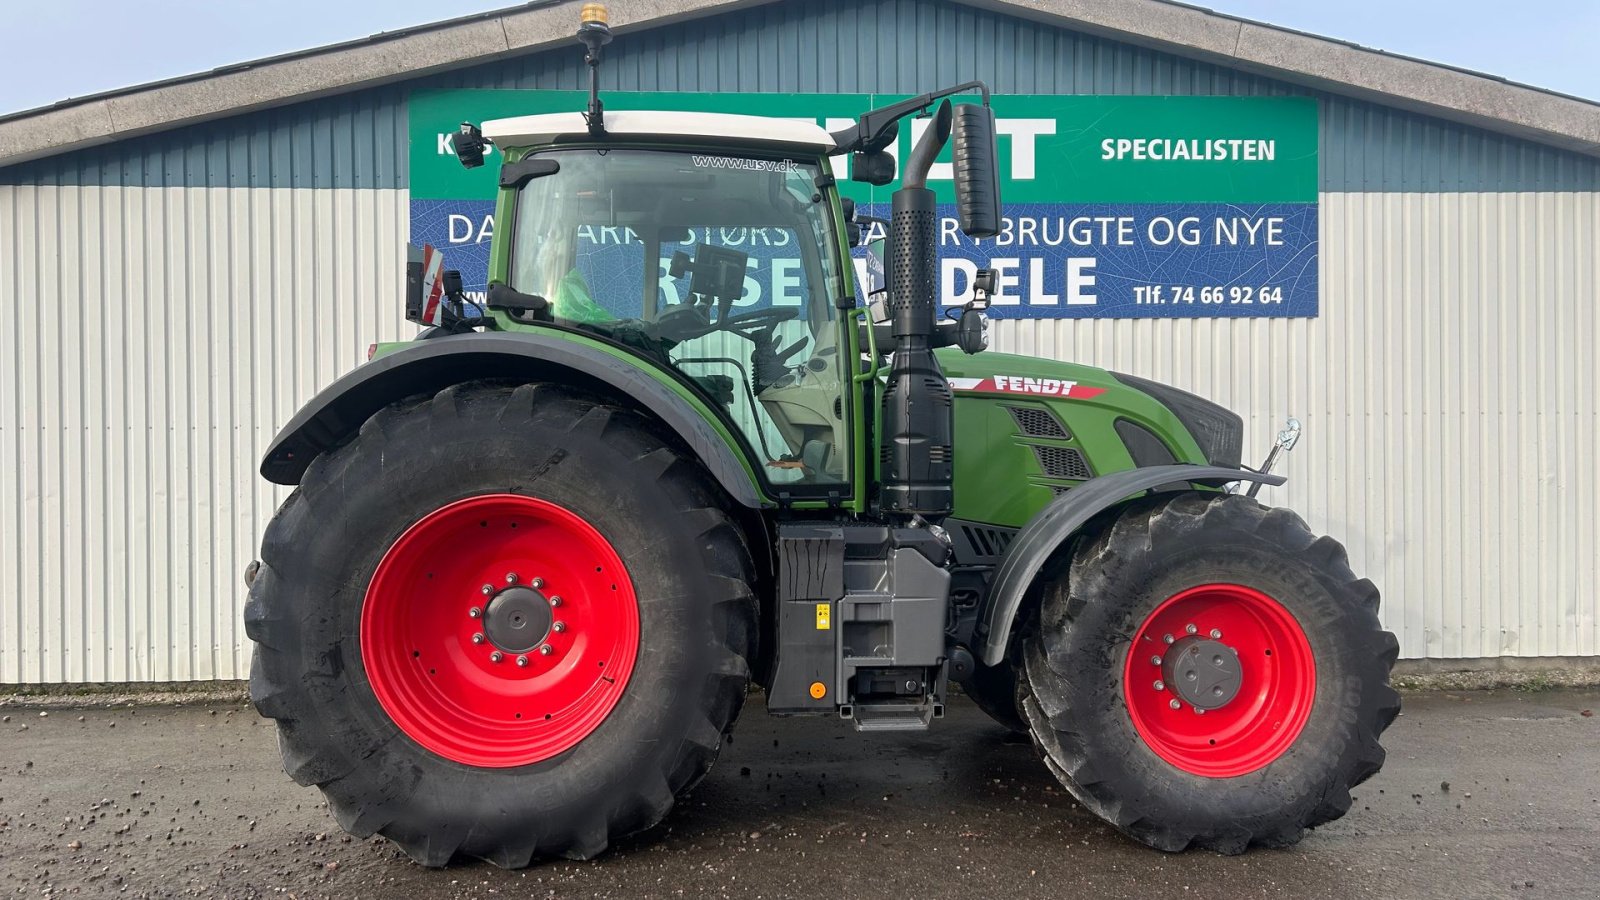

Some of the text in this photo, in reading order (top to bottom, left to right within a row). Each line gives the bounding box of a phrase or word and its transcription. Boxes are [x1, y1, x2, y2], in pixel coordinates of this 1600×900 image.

[1101, 138, 1276, 161] SPECIALISTEN
[691, 155, 799, 173] www.usv.dk
[1148, 217, 1200, 246] OG
[1215, 217, 1284, 246] NYE
[1133, 285, 1283, 304] Tlf. 74 66 92 64
[993, 375, 1077, 396] FENDT
